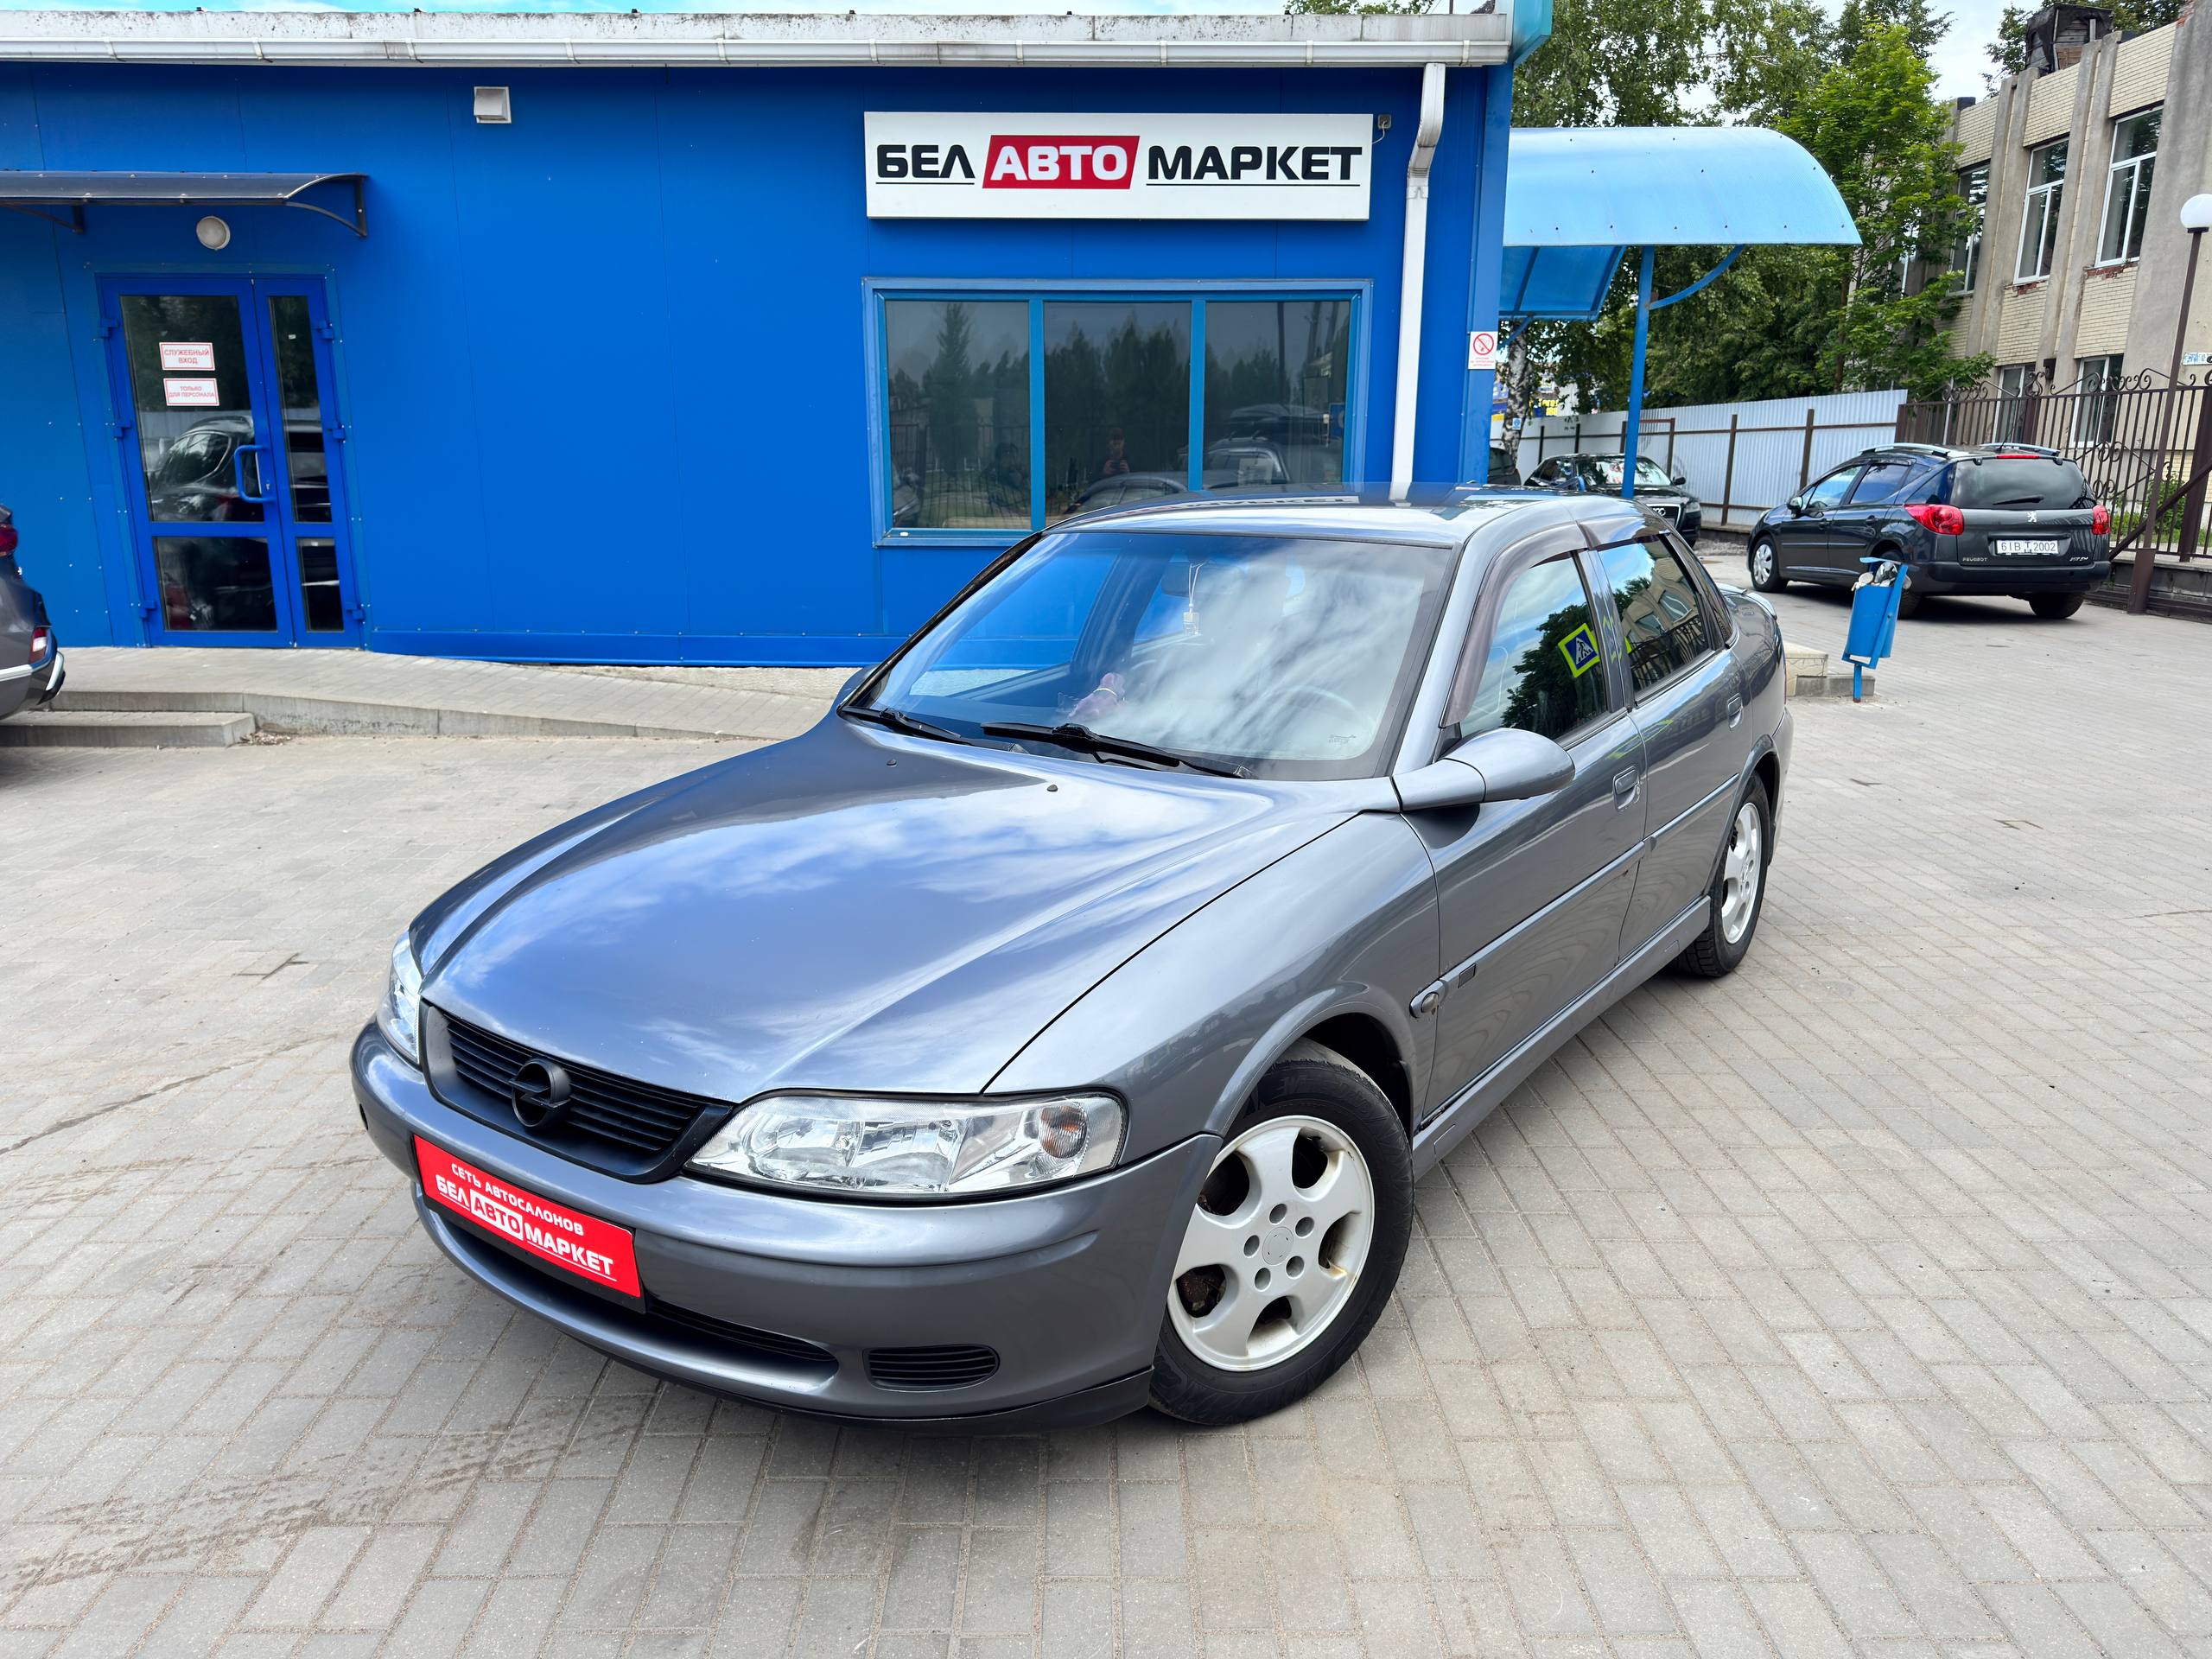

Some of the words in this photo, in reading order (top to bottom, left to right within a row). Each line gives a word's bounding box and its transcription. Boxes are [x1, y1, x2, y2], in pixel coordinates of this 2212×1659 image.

[876, 144, 976, 178] БЕЛ
[990, 145, 1128, 180] АВТО
[1147, 146, 1363, 180] МАРКЕТ
[2033, 542, 2056, 552] 2002
[435, 1174, 470, 1207] БЕЛ
[474, 1195, 522, 1234] АВТО
[524, 1222, 613, 1275] МАРКЕТ
[451, 1163, 481, 1188] СЕТЬ
[485, 1182, 584, 1236] АВТОСАЛОНОВ
